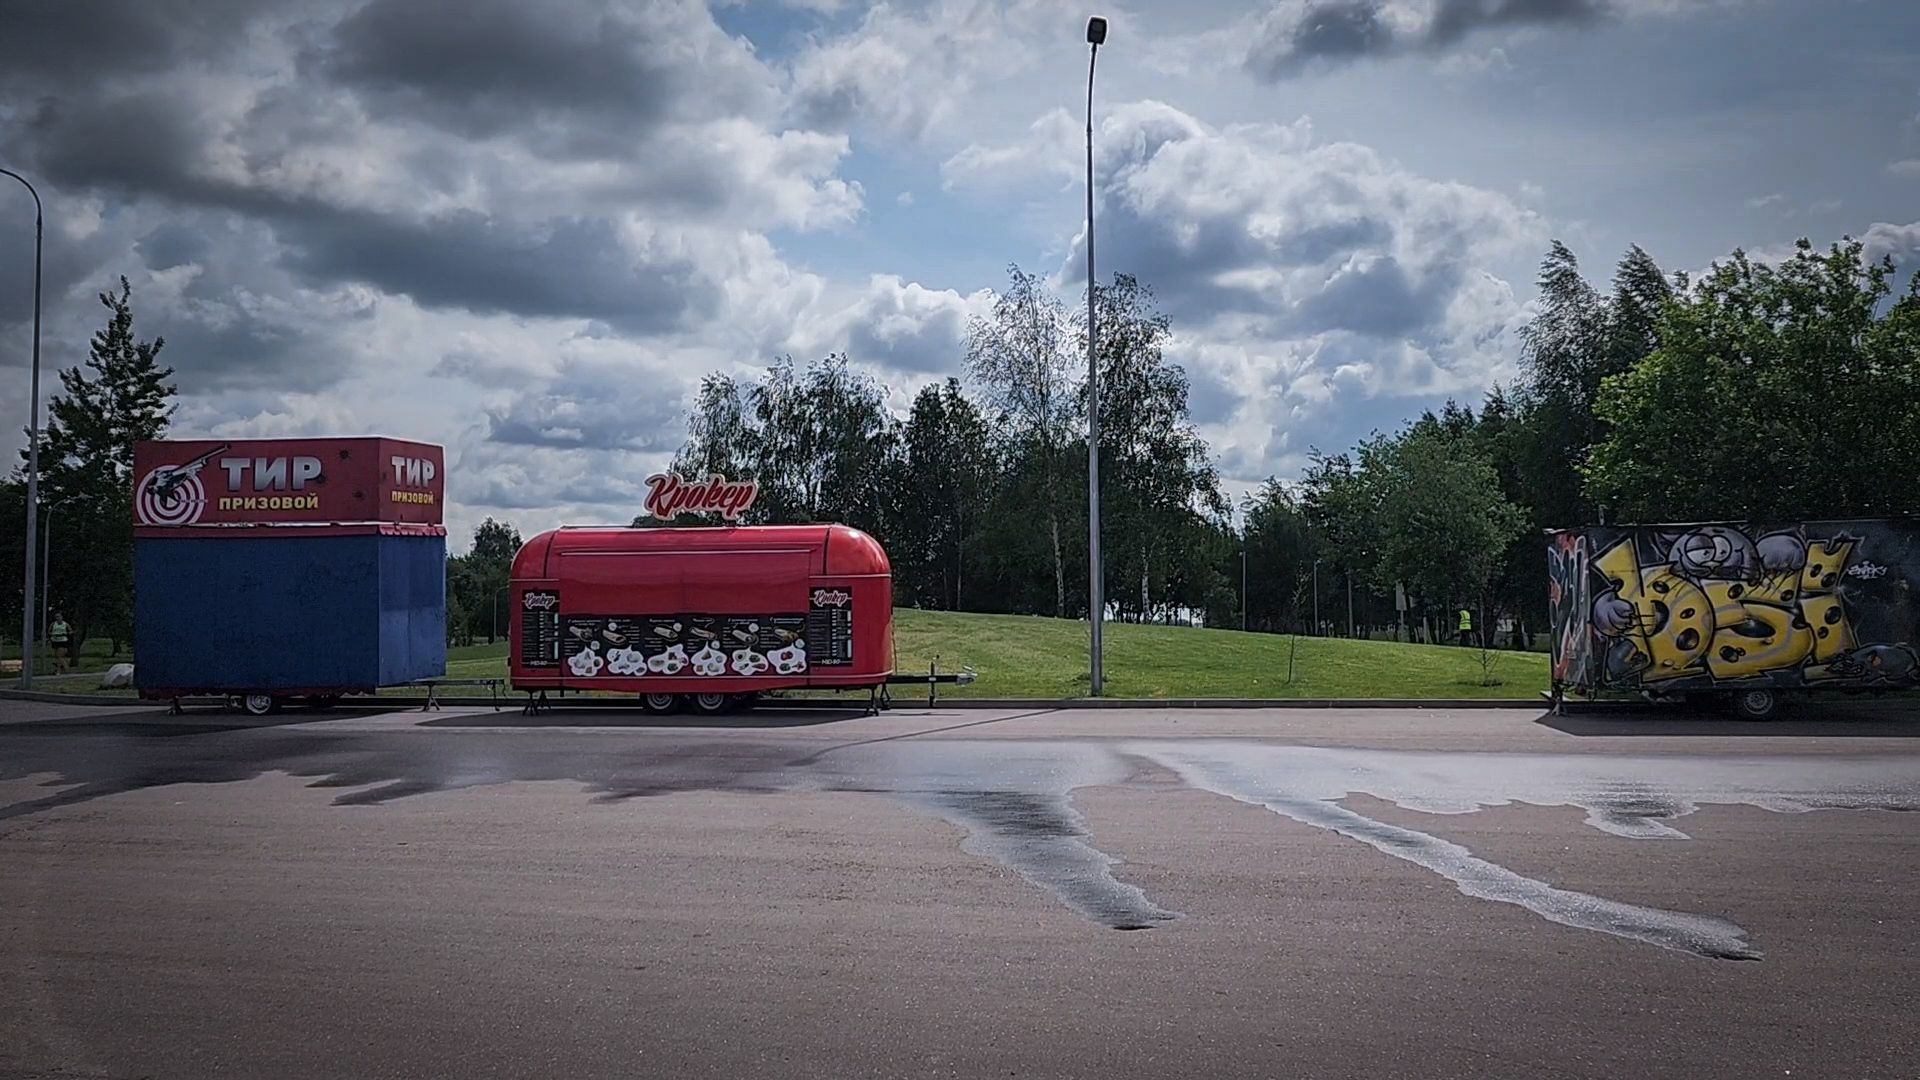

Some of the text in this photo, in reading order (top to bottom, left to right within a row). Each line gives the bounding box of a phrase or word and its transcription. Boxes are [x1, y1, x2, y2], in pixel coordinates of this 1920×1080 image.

[220, 456, 323, 491] ТИР
[391, 456, 435, 488] ТИР
[219, 492, 319, 510] ПРИЗОВОЙ
[391, 490, 434, 505] ПРИЗОВОЙ
[644, 475, 757, 519] Крокер
